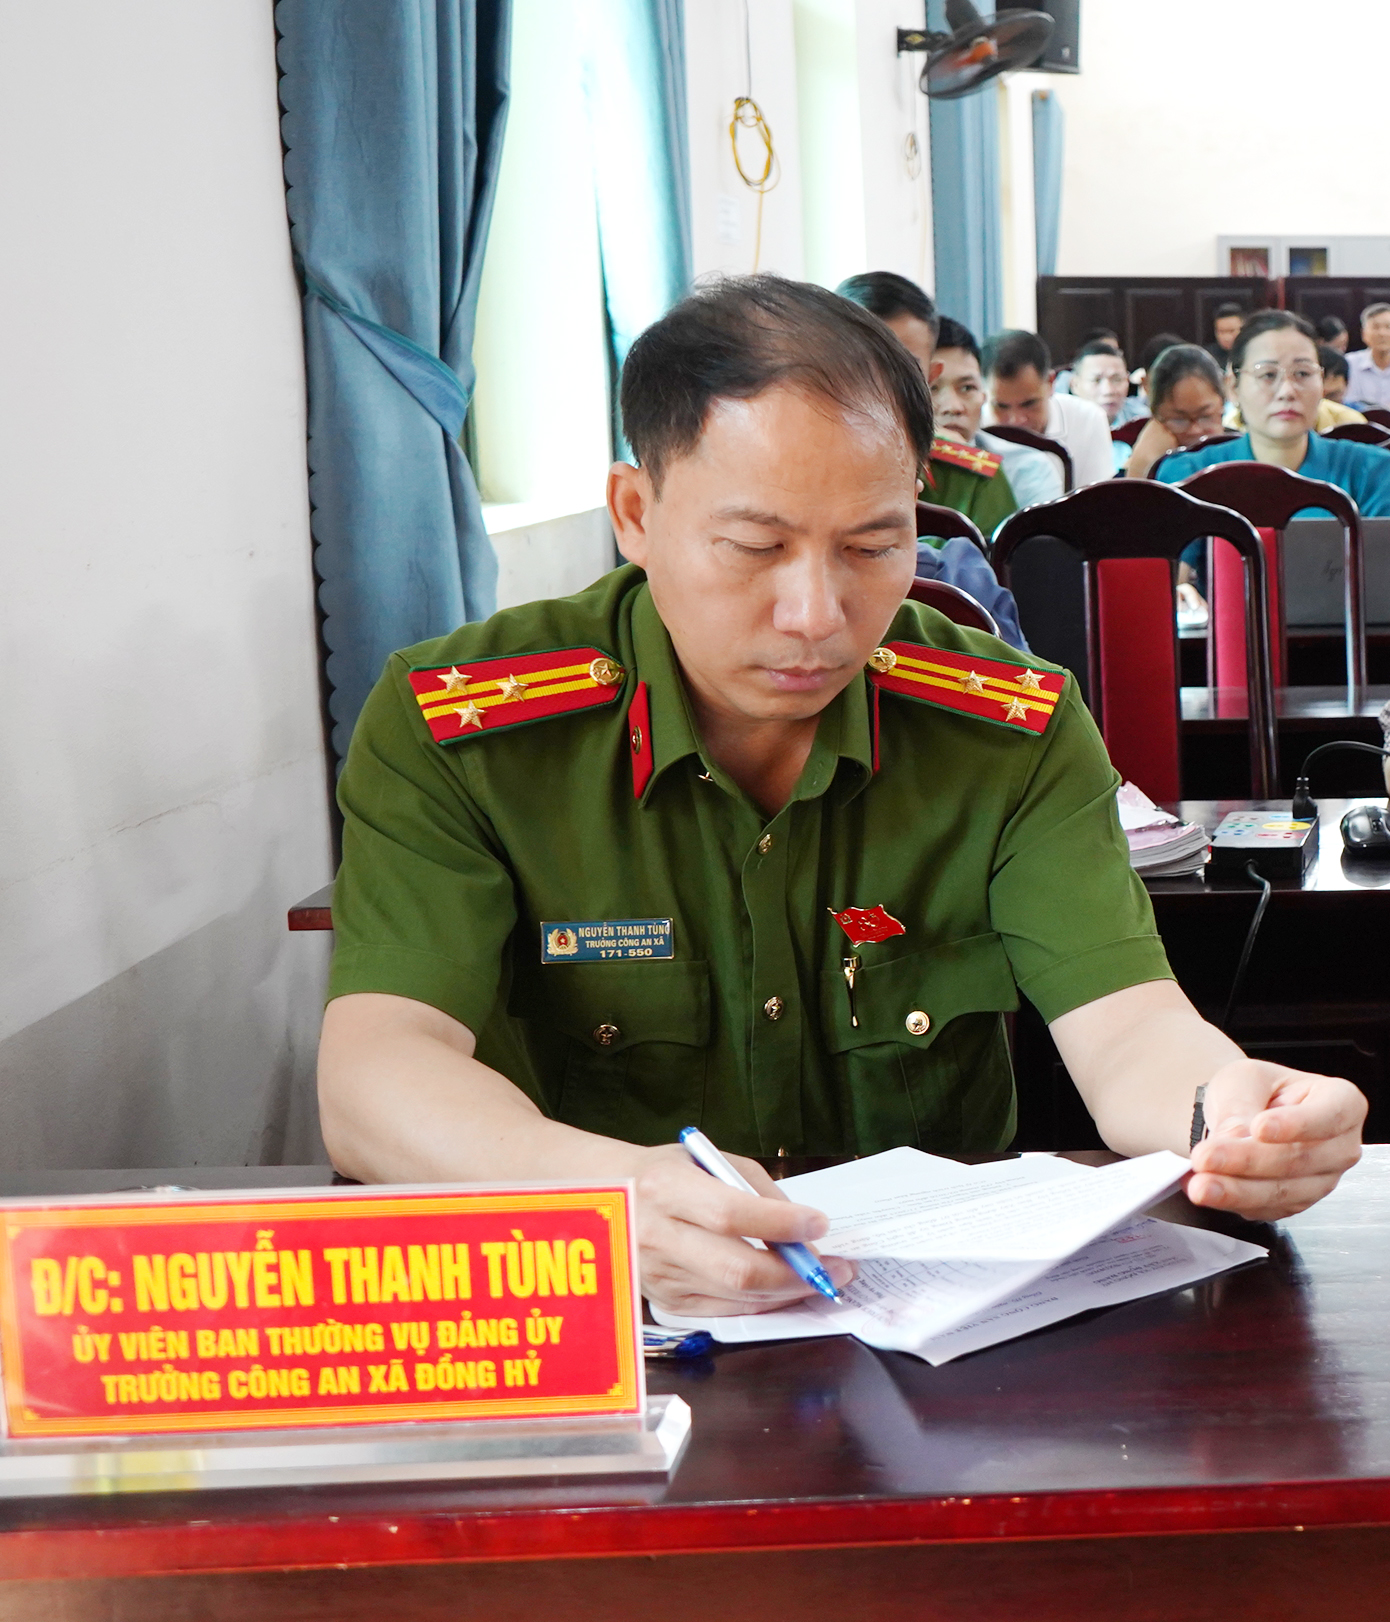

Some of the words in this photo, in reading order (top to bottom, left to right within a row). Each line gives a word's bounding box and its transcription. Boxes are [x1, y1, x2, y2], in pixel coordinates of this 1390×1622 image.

[578, 921, 614, 938] NGUYỄN
[616, 925, 646, 936] THANH
[648, 922, 671, 935] TÙNG
[618, 937, 640, 947] CÔNG
[641, 938, 652, 946] AN
[653, 936, 665, 946] XÃ
[30, 1255, 124, 1317] Đ/C:
[132, 1229, 315, 1313] NGUYỄN
[323, 1243, 472, 1305] THANH
[480, 1229, 598, 1299] TÙNG
[71, 1324, 113, 1364] ỦY
[117, 1325, 190, 1362] VIÊN
[195, 1327, 260, 1359] BAN
[264, 1318, 385, 1357] THƯỜNG
[389, 1321, 431, 1357] VỤ
[435, 1310, 520, 1350] ĐẢNG
[525, 1307, 564, 1346] ỦY
[99, 1363, 222, 1405] TRƯỞNG
[227, 1364, 311, 1400] CÔNG
[317, 1365, 361, 1396] AN
[366, 1358, 410, 1394] XÃ
[414, 1352, 497, 1392] ĐỒNG
[503, 1349, 542, 1387] HỶ
